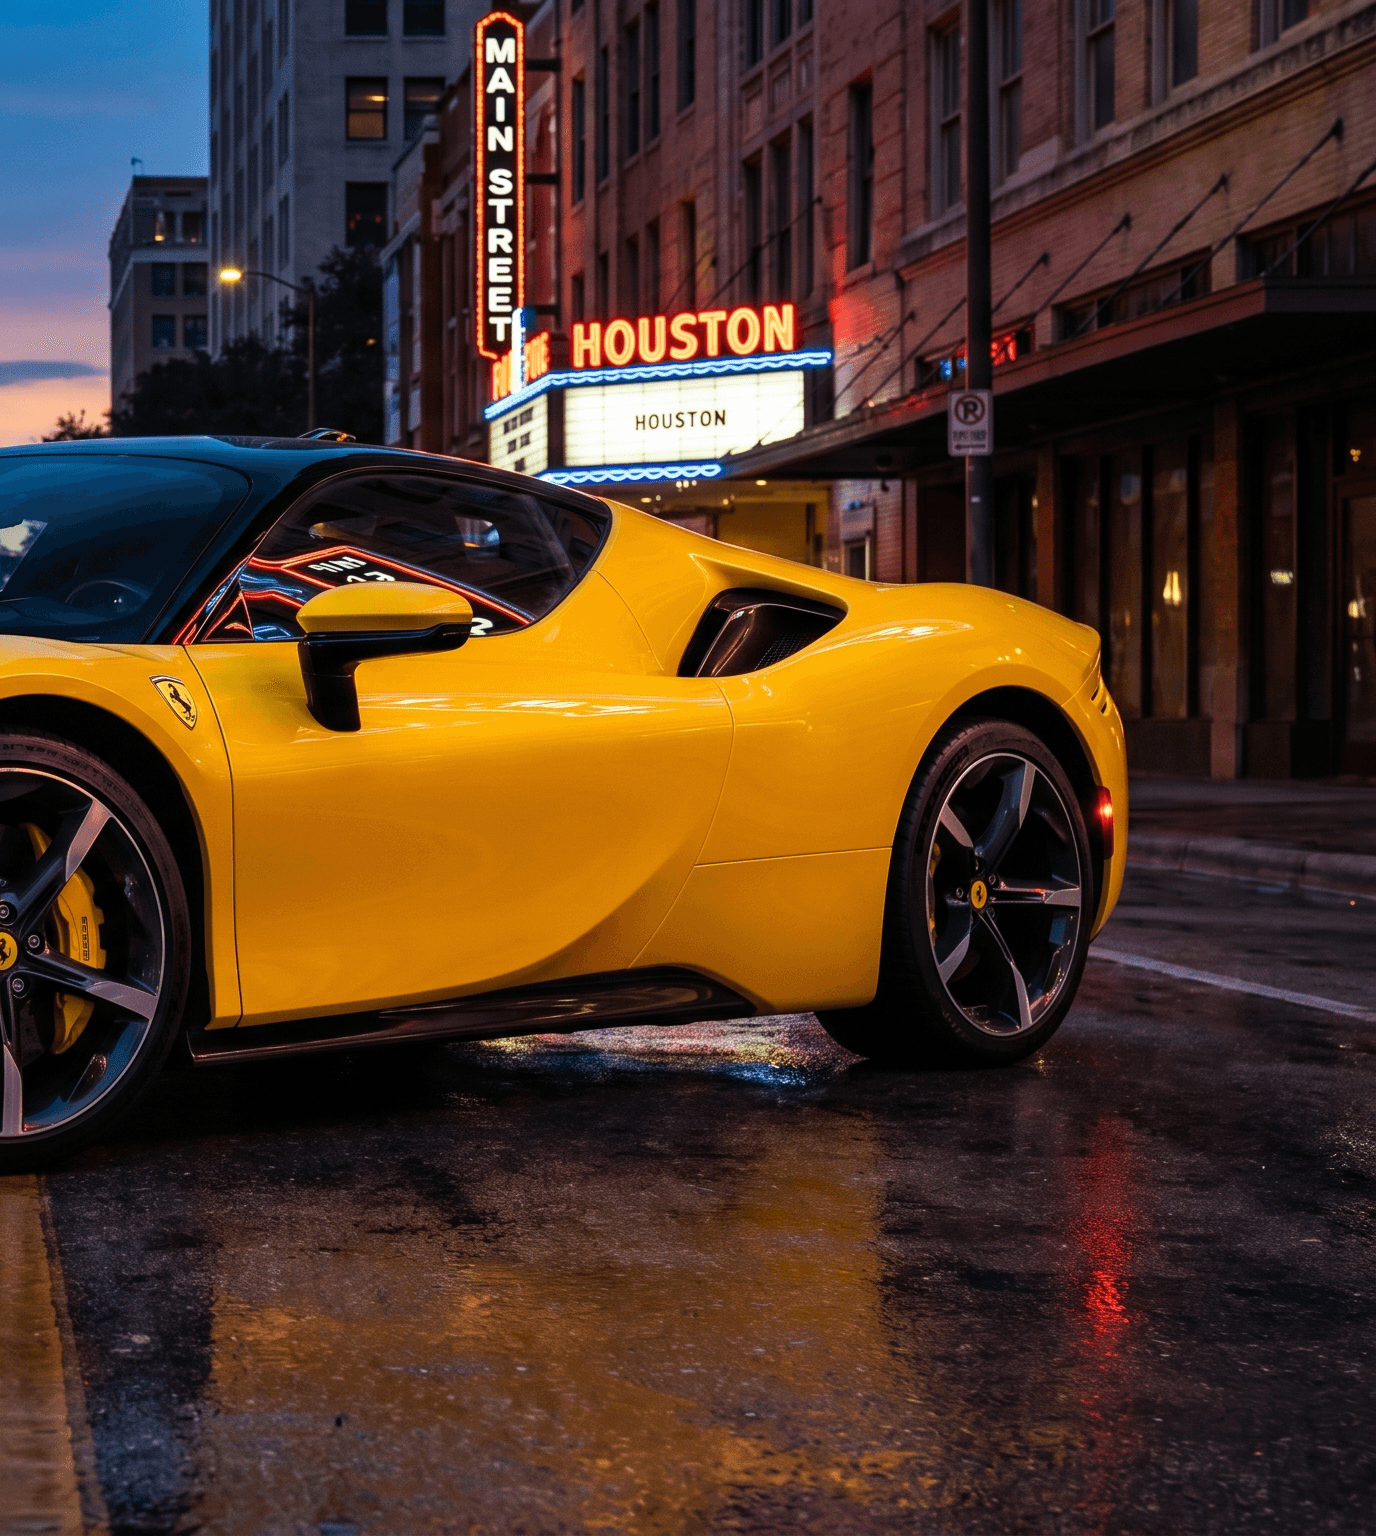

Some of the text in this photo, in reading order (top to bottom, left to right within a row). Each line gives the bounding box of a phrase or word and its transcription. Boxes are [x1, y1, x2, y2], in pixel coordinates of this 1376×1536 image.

[485, 38, 515, 341] MAIN STREET
[573, 303, 794, 368] HOUSTON
[635, 410, 726, 431] HOUSTON
